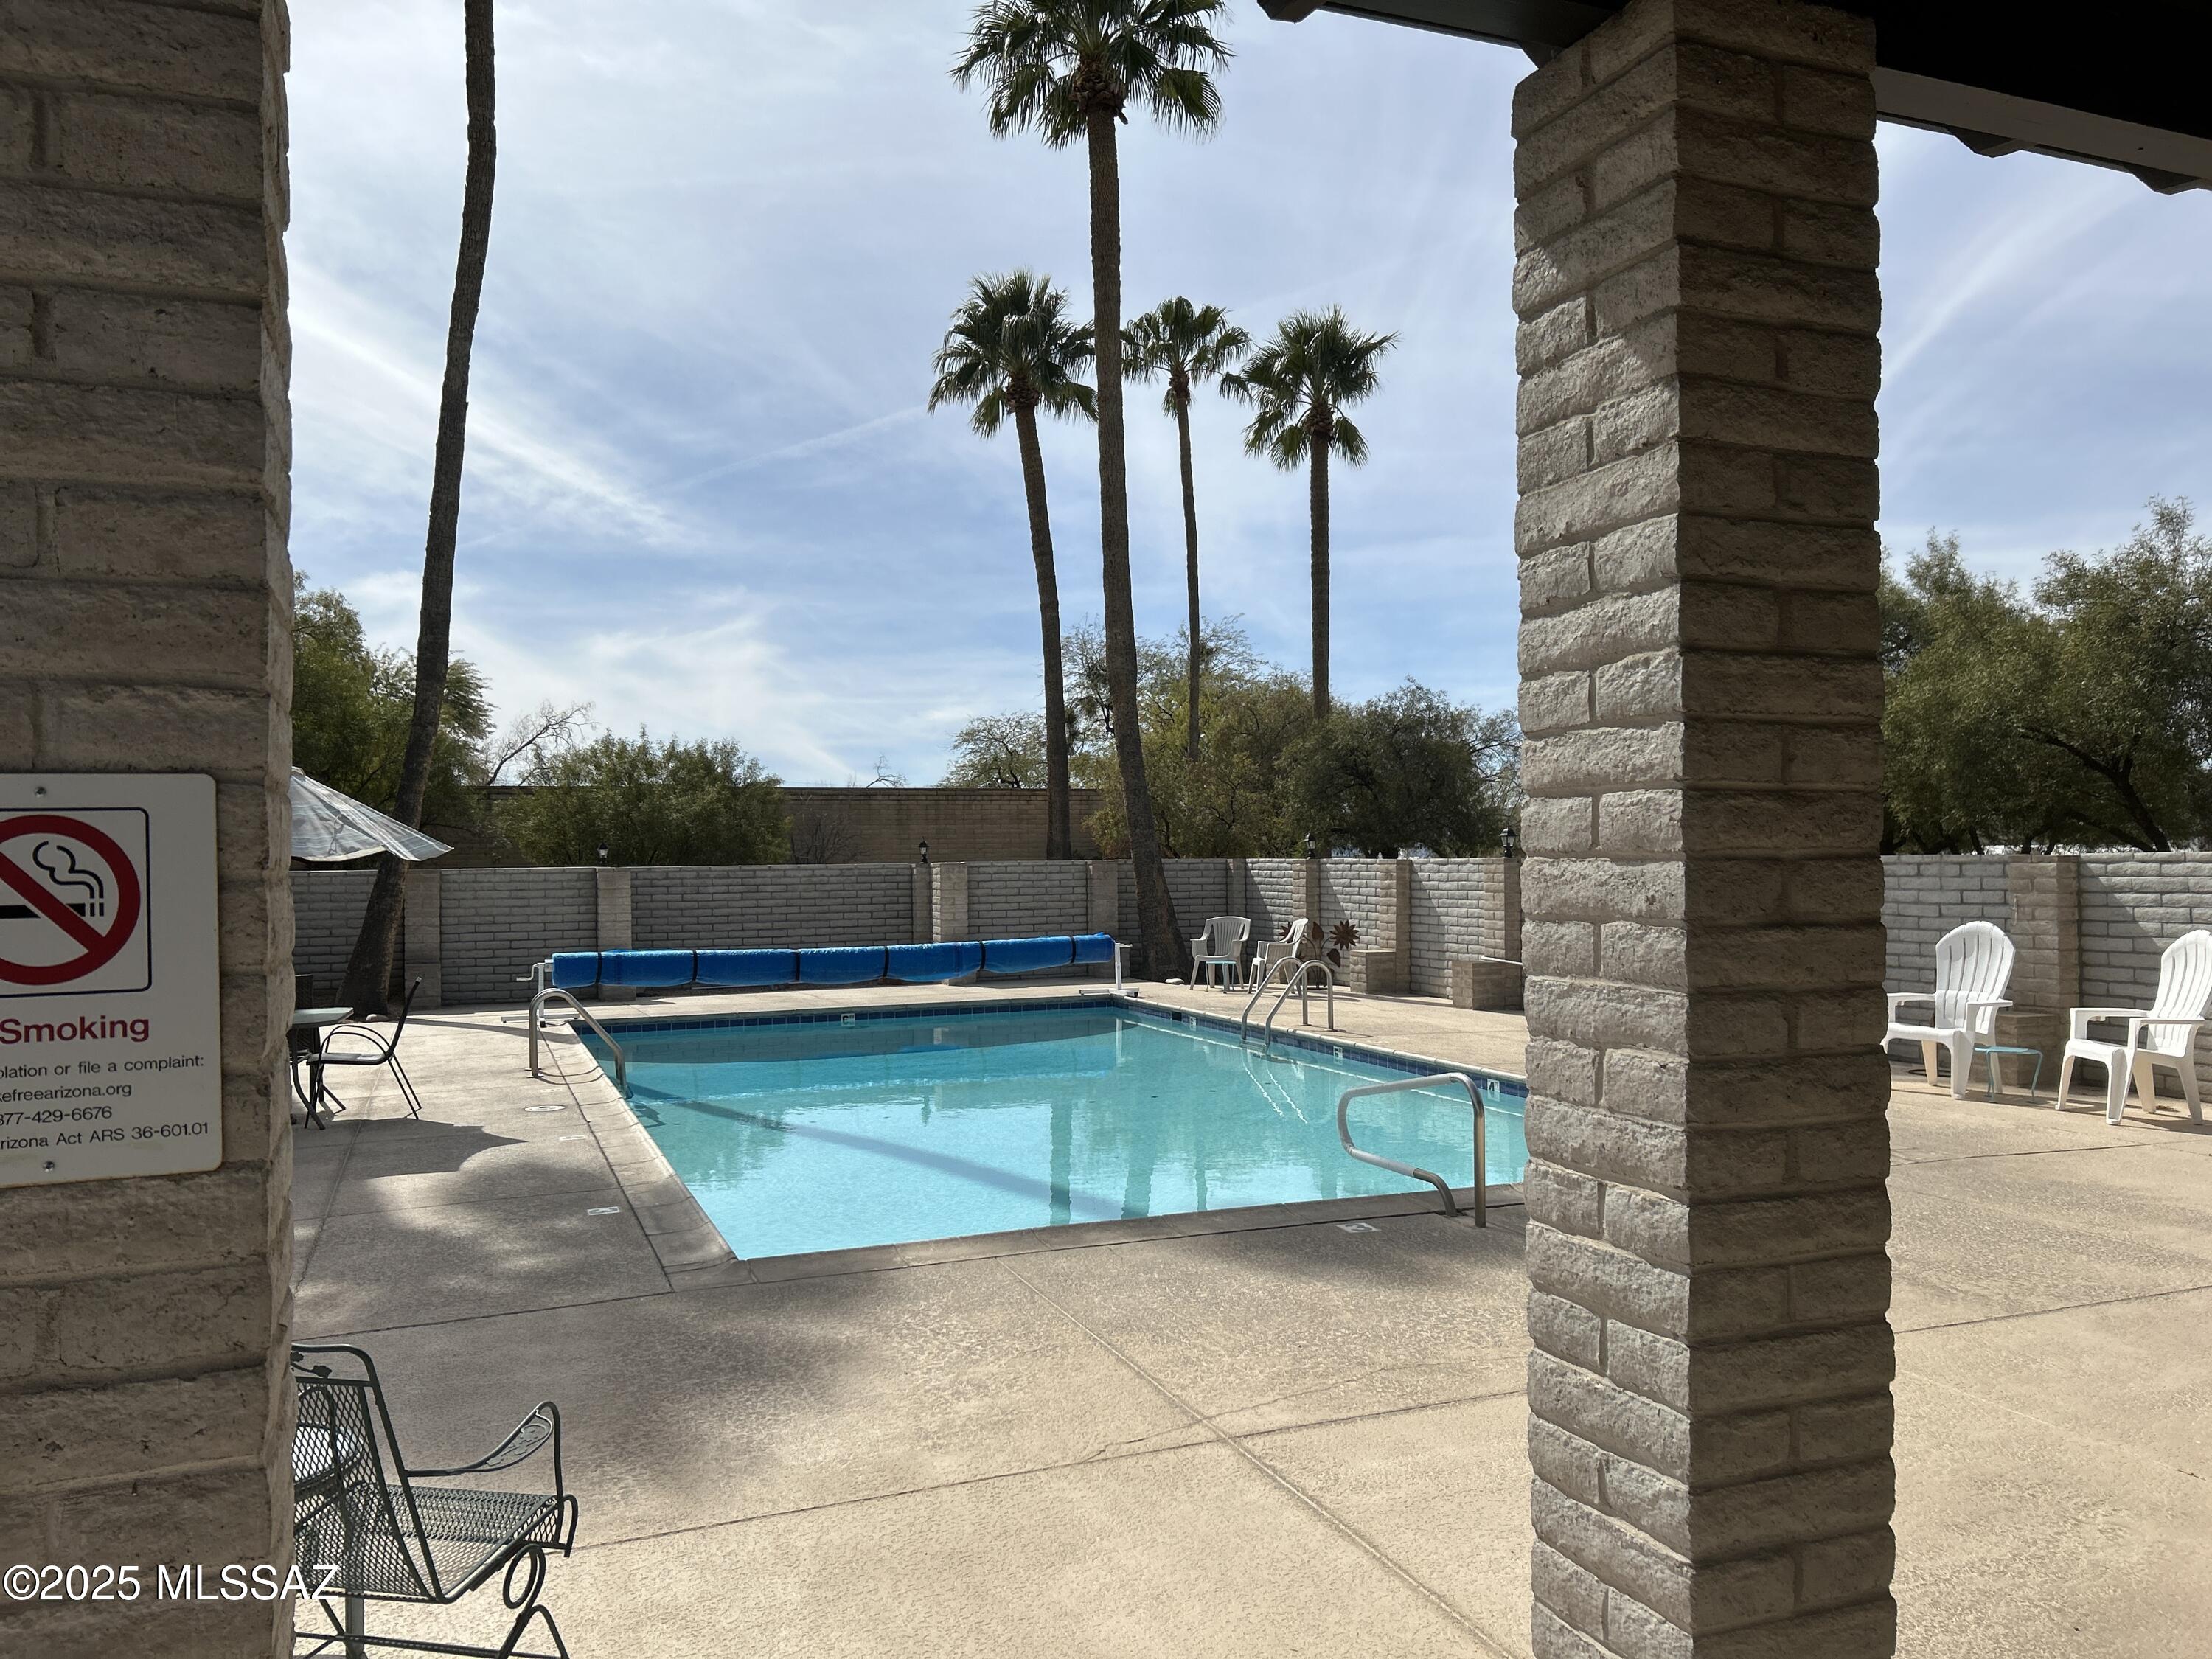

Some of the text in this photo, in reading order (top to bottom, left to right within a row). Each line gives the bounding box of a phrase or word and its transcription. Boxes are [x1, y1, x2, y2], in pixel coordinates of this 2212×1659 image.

[0, 1015, 149, 1045] Smoking
[54, 1064, 71, 1076] or
[78, 1061, 101, 1074] file
[108, 1062, 117, 1073] a
[124, 1055, 204, 1071] complaint:
[0, 1084, 131, 1103] efreearizona.org
[56, 1132, 83, 1146] Act
[89, 1127, 125, 1144] ARS
[131, 1121, 209, 1140] 36-601.01
